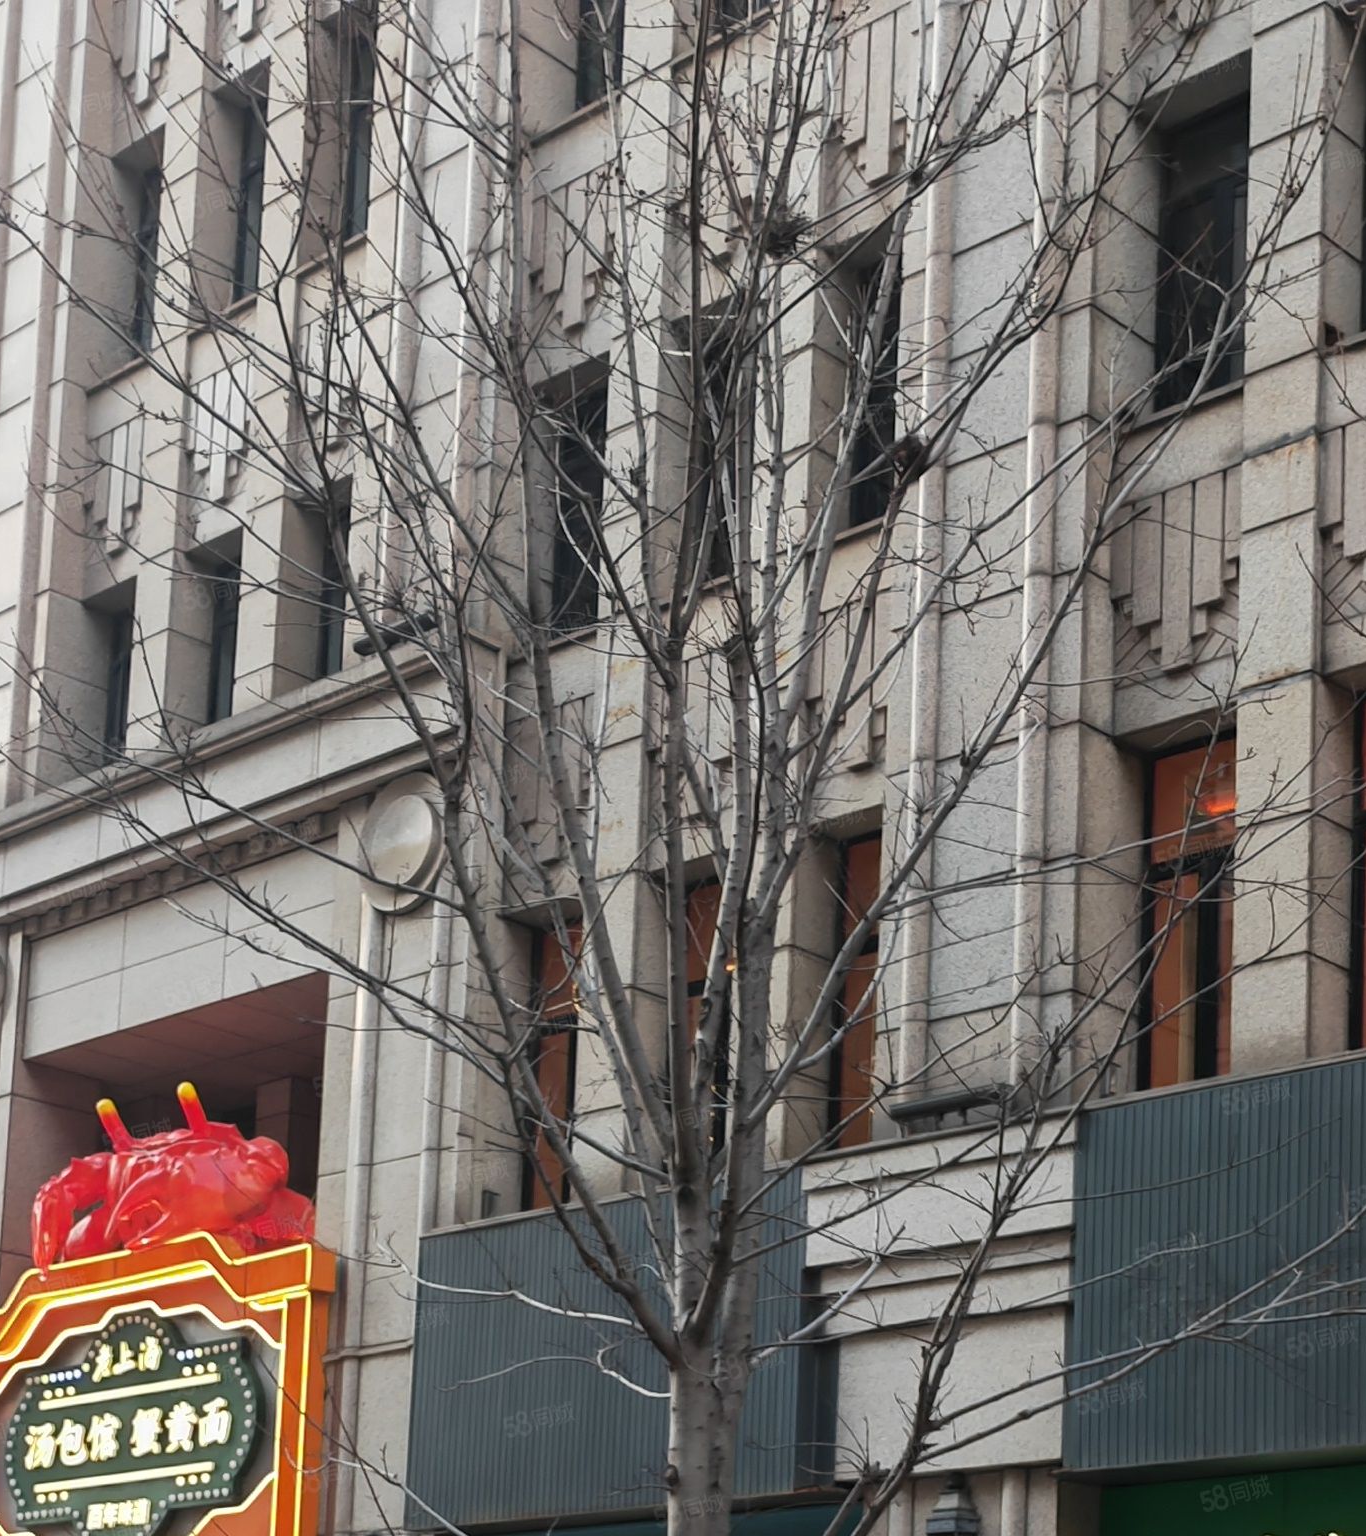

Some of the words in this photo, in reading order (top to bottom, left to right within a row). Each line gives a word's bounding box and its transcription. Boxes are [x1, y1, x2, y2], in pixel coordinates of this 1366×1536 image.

[24, 1413, 123, 1470] 汤包馆
[131, 1397, 233, 1458] 蟹黄面
